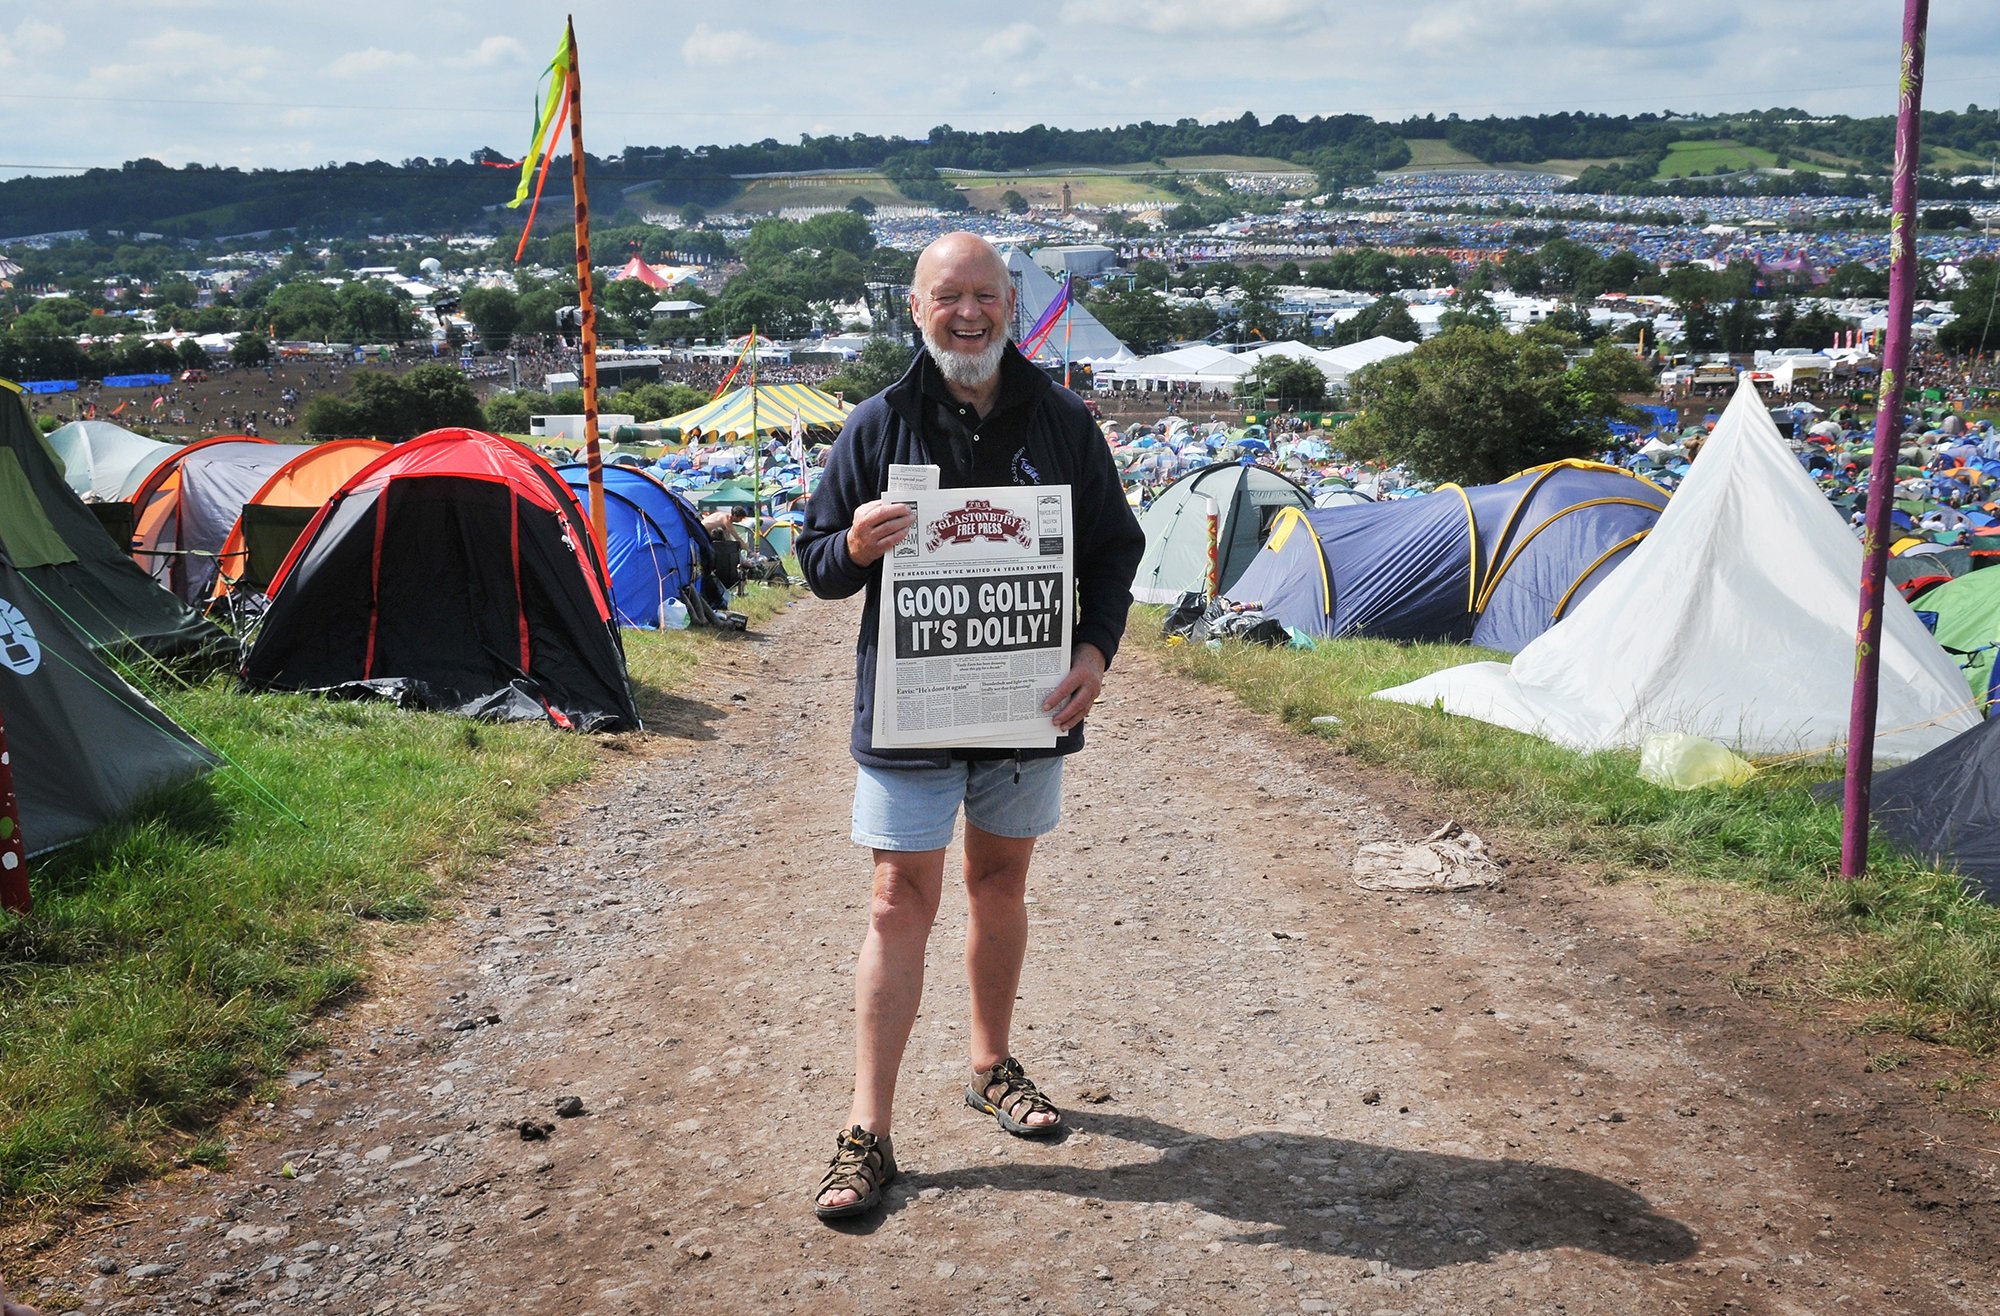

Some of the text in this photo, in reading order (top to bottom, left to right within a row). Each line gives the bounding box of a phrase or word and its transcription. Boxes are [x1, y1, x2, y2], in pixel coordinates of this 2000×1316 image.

[938, 512, 1020, 530] GLASTONBURY
[957, 522, 1003, 536] FREE PRESS
[897, 579, 1061, 618] GOOD GOLLY,
[912, 613, 1050, 651] IT’S DOLLY!
